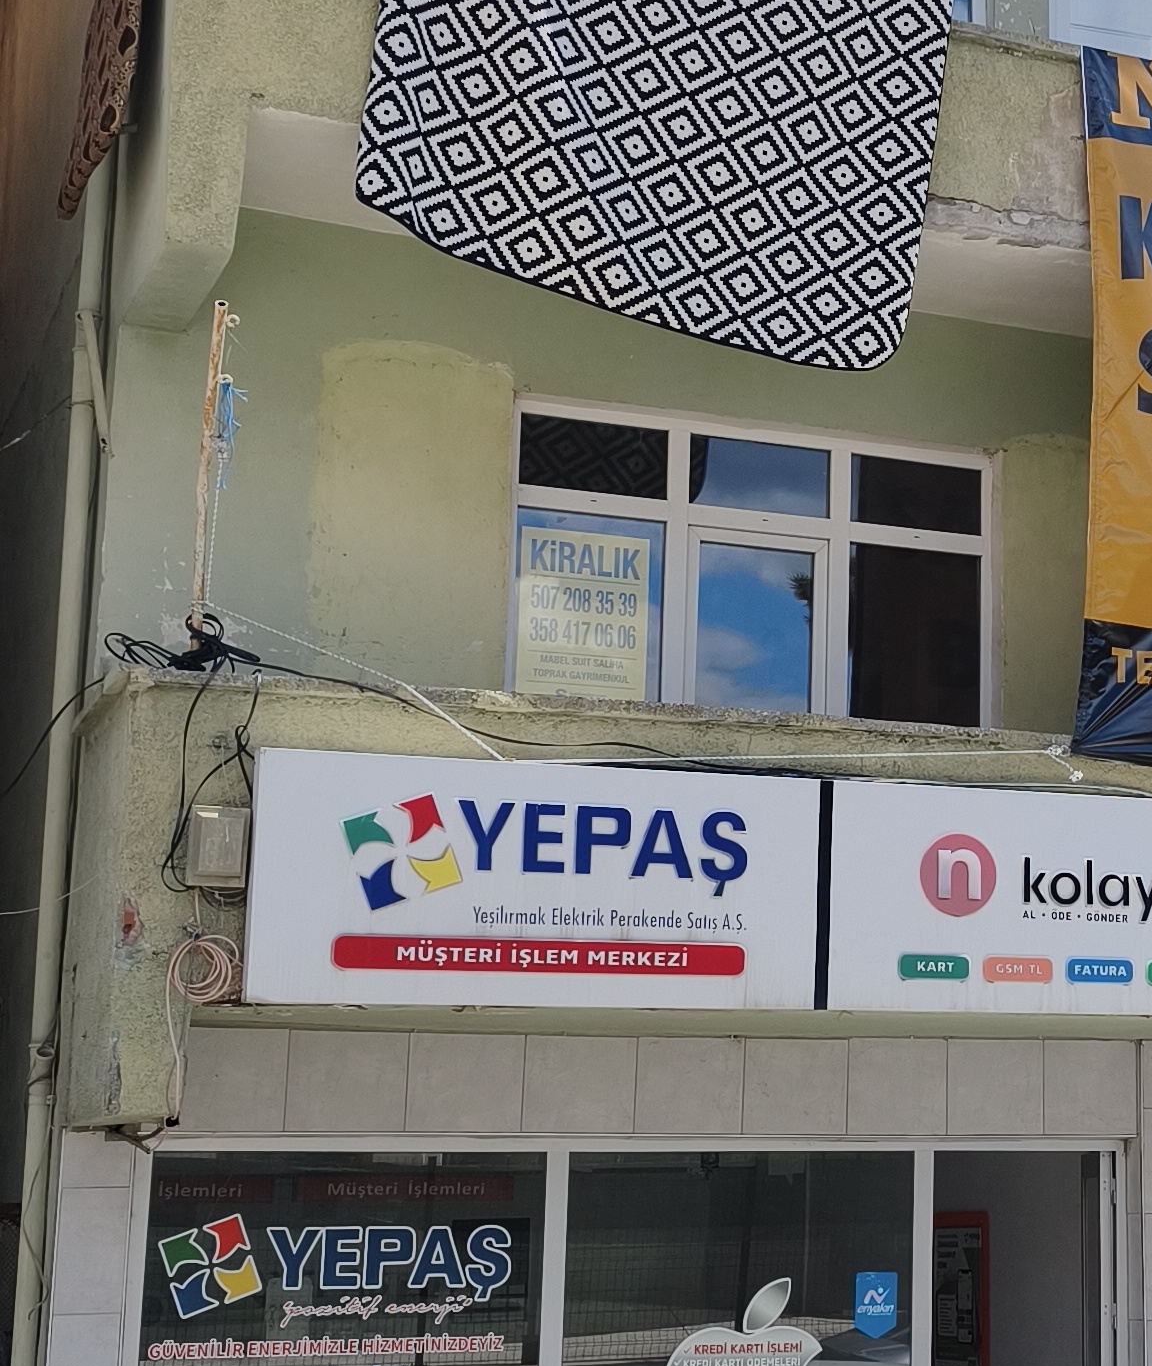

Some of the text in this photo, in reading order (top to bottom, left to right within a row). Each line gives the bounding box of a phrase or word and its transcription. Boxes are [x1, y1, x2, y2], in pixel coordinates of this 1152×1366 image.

[530, 584, 637, 617] 507 208 35 39
[529, 617, 637, 650] 358 417 06 06
[540, 654, 570, 666] MABEL
[533, 667, 568, 679] TOPRAK
[456, 797, 749, 897] YEPAŞ
[473, 905, 546, 929] Yeşilırmak
[551, 907, 604, 928] Elektrik
[610, 909, 682, 929] Perakende
[687, 912, 718, 934] Satış
[1022, 909, 1036, 920] AL
[1086, 910, 1129, 923] GÖNDER
[396, 941, 689, 968] MÜŞTERİ İŞLEM MERKEZİ
[916, 960, 955, 973] KART
[995, 962, 1044, 975] GSM TL
[1074, 963, 1127, 978] FATURA
[158, 1180, 242, 1200] İşlemleri
[327, 1180, 486, 1198] Müşteri İşlemleri
[267, 1225, 511, 1301] YEPAŞ
[148, 1332, 504, 1360] GÜVENİLİR ENERJİMİZLE HİZMETİNİZDEYİZ
[694, 1340, 802, 1355] KREDİ KARTI İŞLEMİ
[747, 1356, 800, 1366] ÖDEMELERİ
